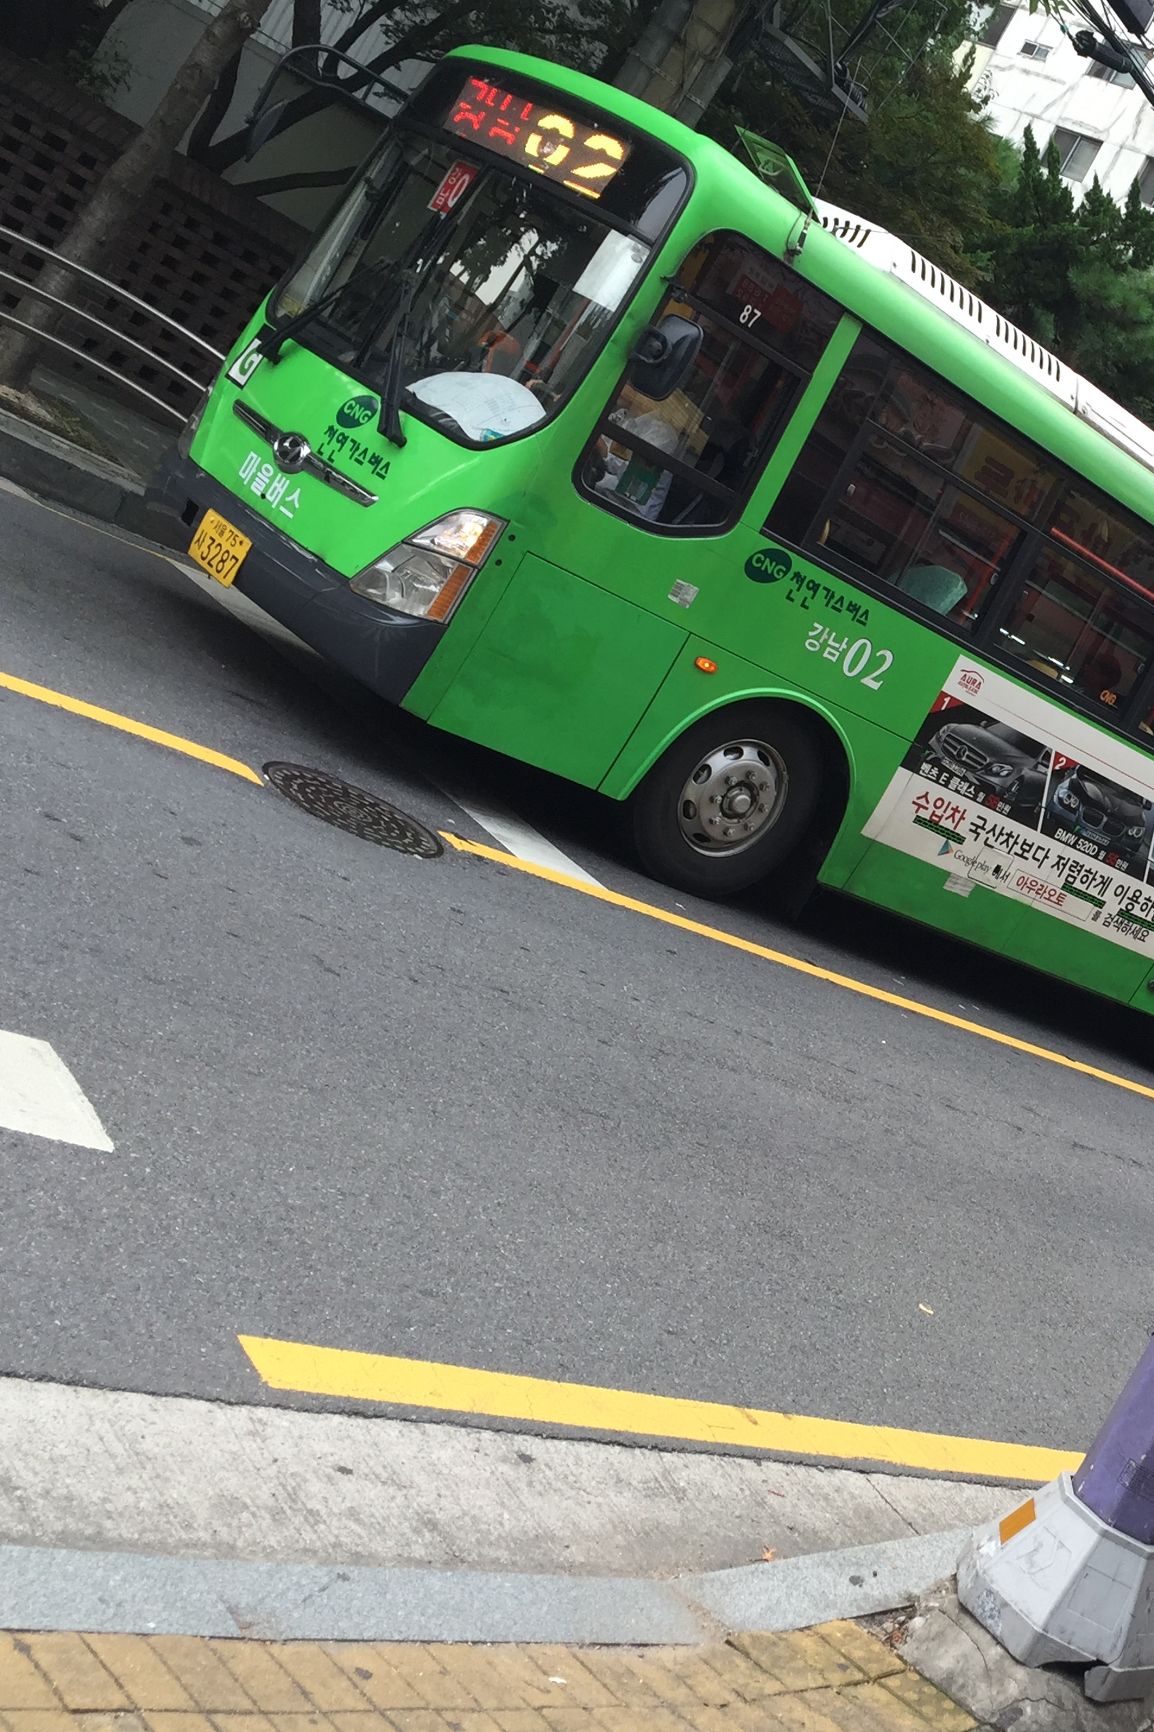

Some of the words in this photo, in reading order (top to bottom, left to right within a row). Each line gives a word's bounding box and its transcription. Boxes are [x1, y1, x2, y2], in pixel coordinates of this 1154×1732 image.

[739, 304, 762, 328] 87
[343, 399, 372, 425] CNG
[316, 424, 392, 481] 천연가스버스
[238, 450, 301, 519] 마을버스
[752, 553, 787, 580] CNG
[785, 571, 870, 627] 천연가스버스
[960, 672, 983, 691] AURA
[940, 696, 951, 711] 1
[1054, 757, 1067, 770] 2
[919, 762, 939, 782] 벤츠
[940, 773, 948, 785] E
[947, 775, 977, 798] 클래스
[911, 791, 967, 831] 수입차
[968, 815, 1051, 869] 국산차보다
[1051, 854, 1113, 898] 저렴하게
[1054, 828, 1077, 848] BMW
[1077, 838, 1099, 856] 520D
[954, 848, 977, 866] Google
[1016, 875, 1069, 907] 아우라오토
[1102, 912, 1150, 943] 검색하세요
